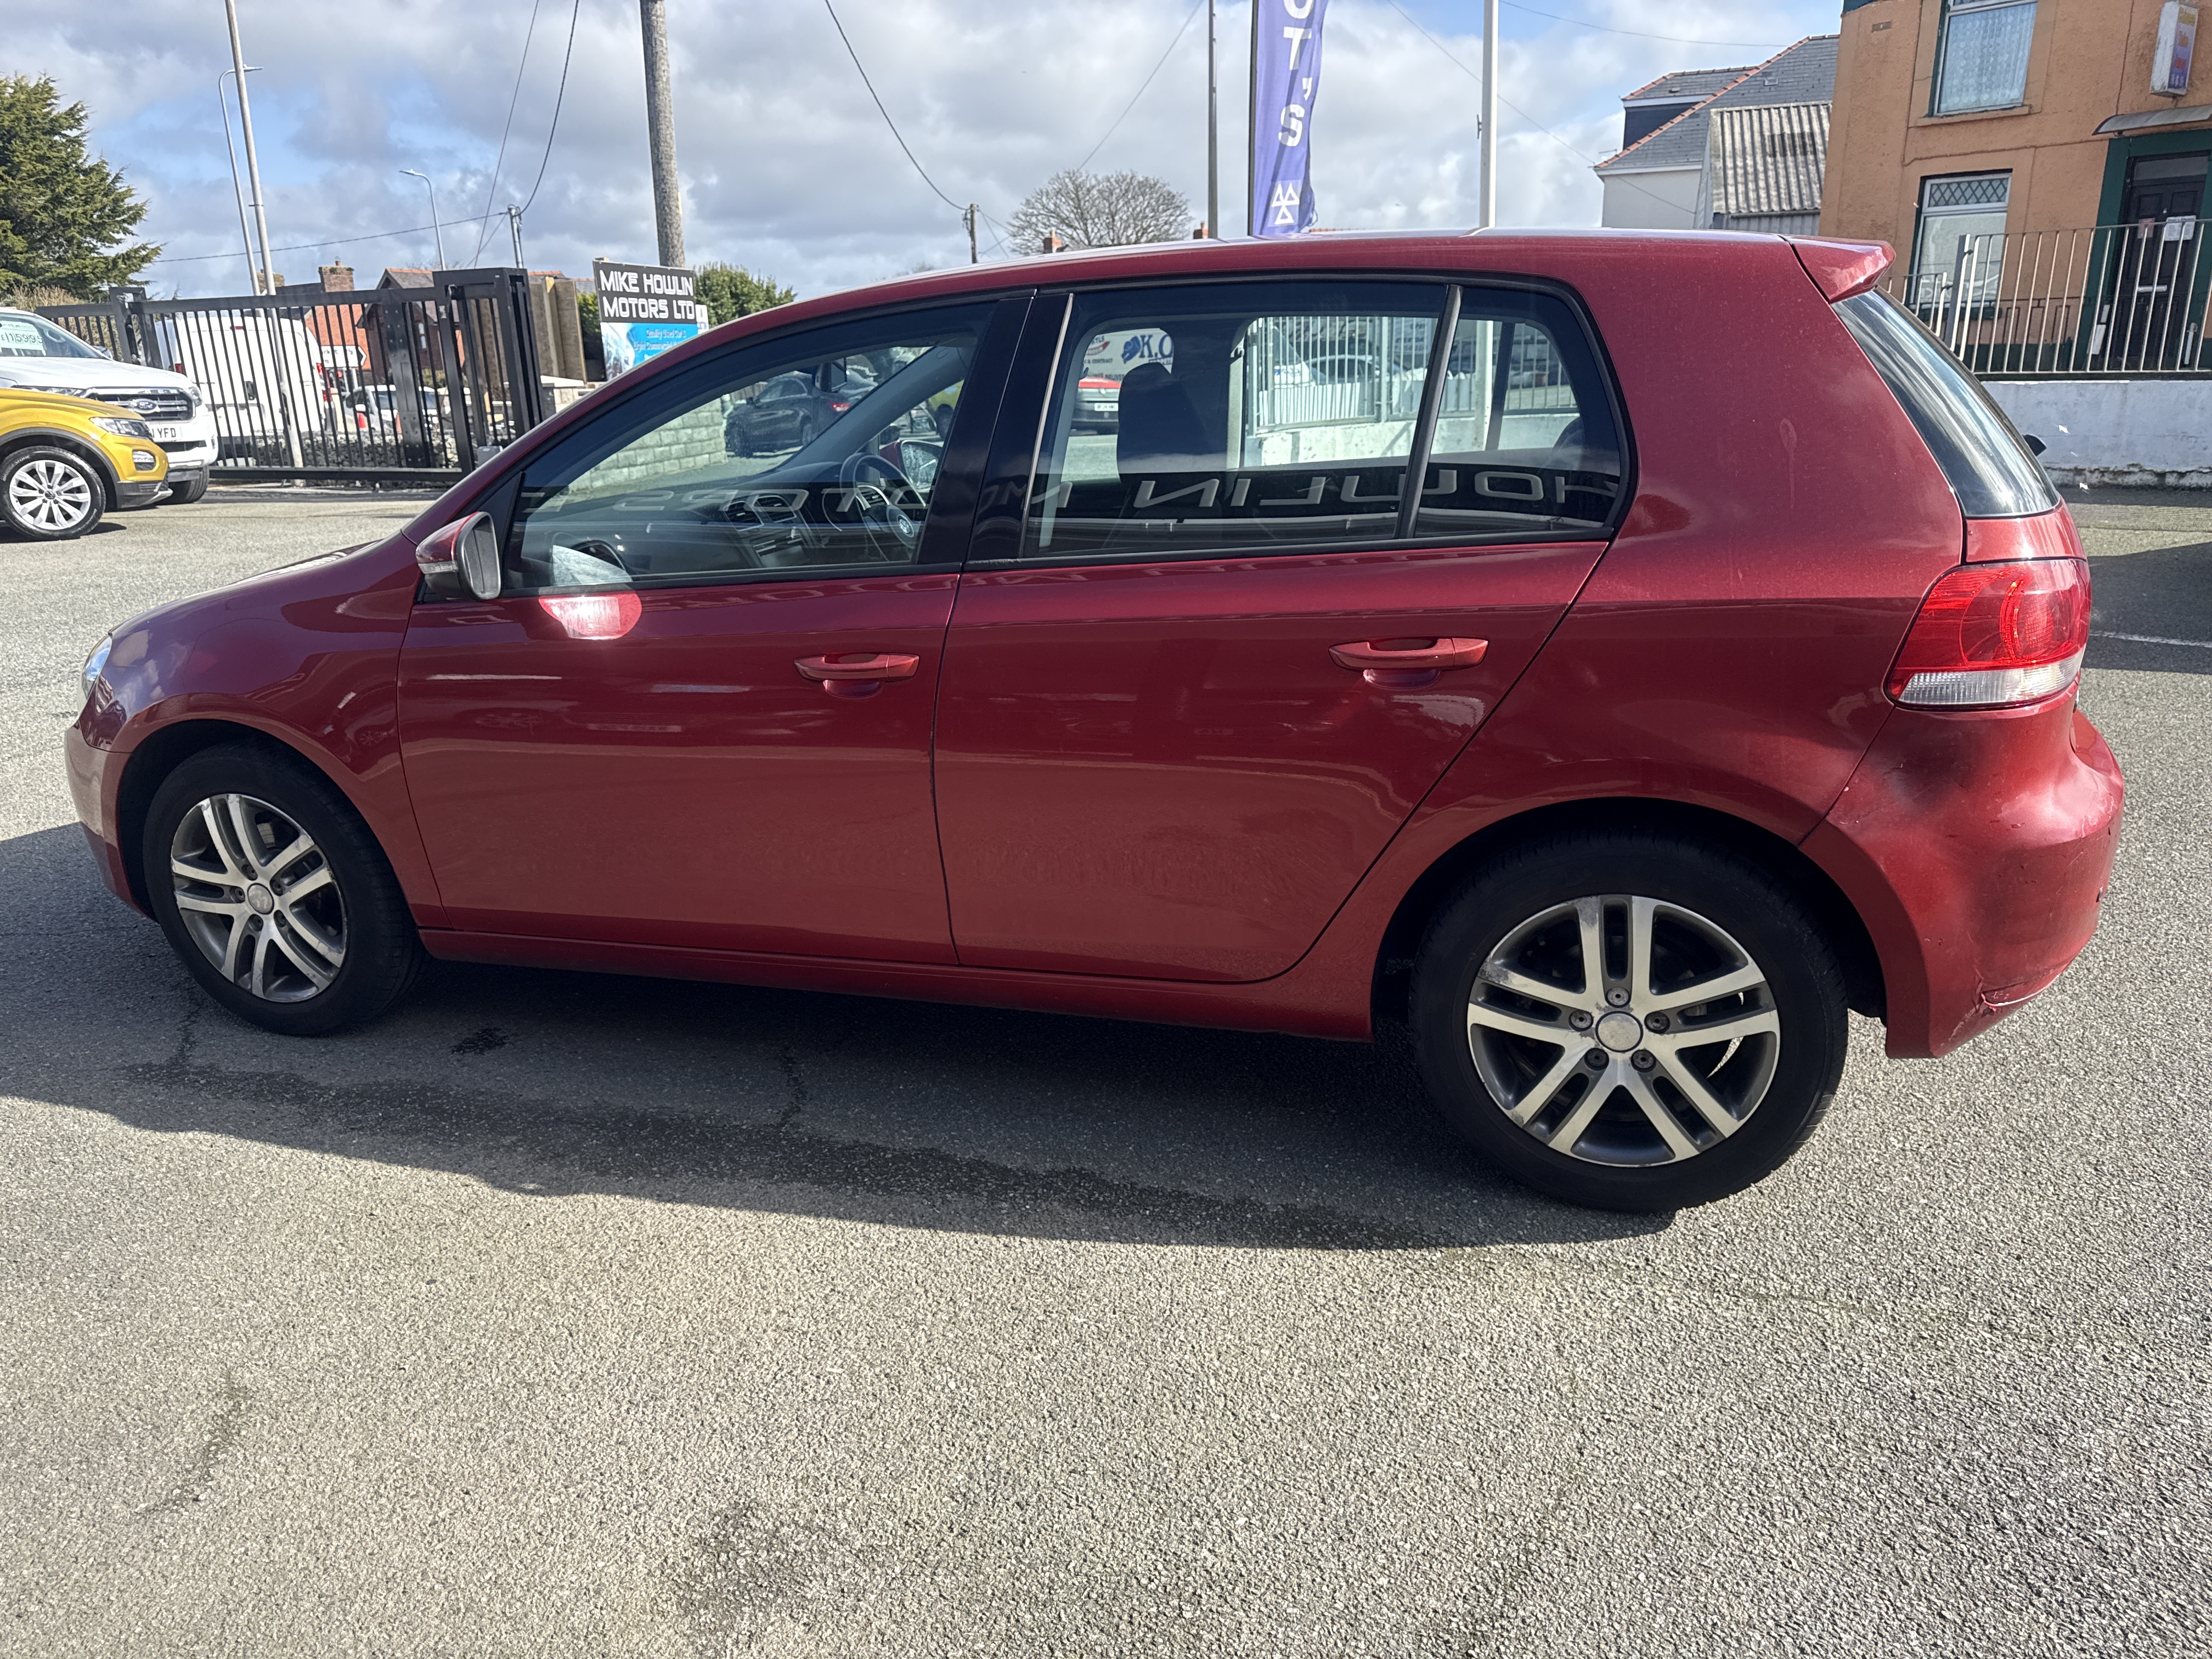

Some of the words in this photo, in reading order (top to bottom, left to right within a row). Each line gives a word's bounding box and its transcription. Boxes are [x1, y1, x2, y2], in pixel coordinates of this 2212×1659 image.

[600, 269, 640, 293] MIKE
[643, 273, 694, 296] HOWLIN
[602, 296, 669, 319] MOTORS
[673, 300, 695, 320] LTD
[157, 428, 176, 438] YFD
